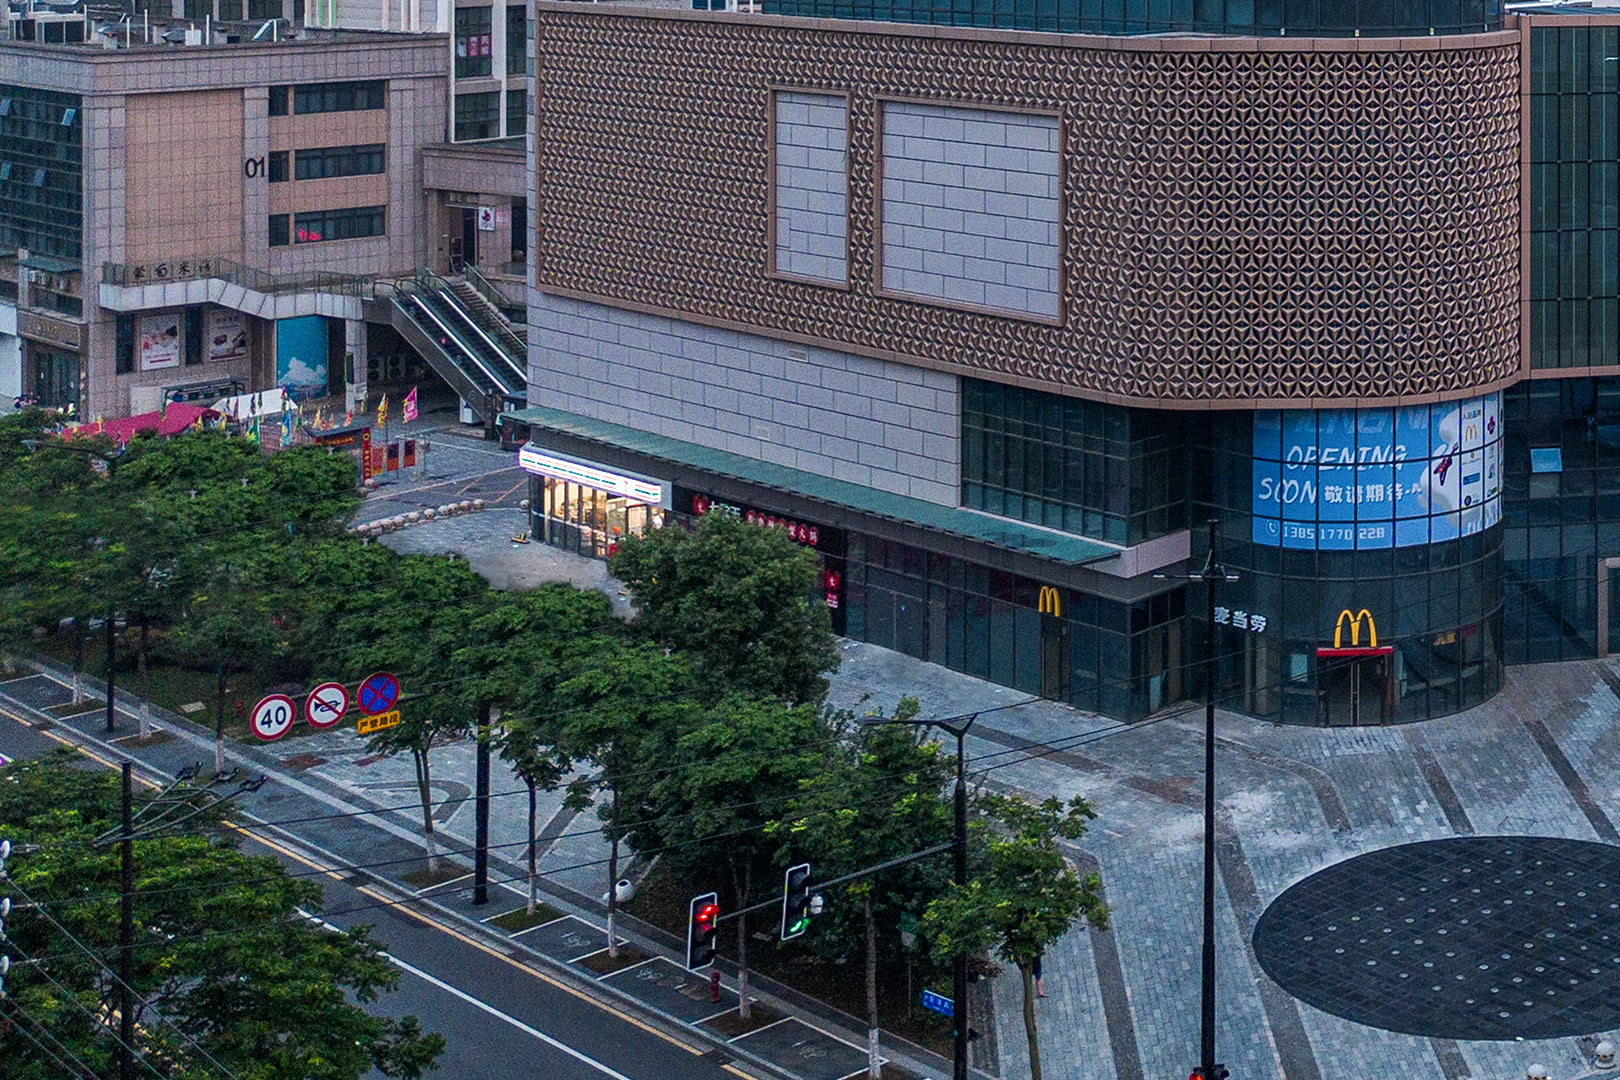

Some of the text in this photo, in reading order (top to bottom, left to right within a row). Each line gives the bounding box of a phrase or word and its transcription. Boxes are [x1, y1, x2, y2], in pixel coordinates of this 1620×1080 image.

[244, 157, 267, 179] 01
[1286, 444, 1408, 471] OPENING
[1258, 477, 1317, 505] SOON
[1213, 606, 1268, 633] 麦当劳
[260, 706, 287, 729] 40
[358, 712, 399, 731] 严管路段
